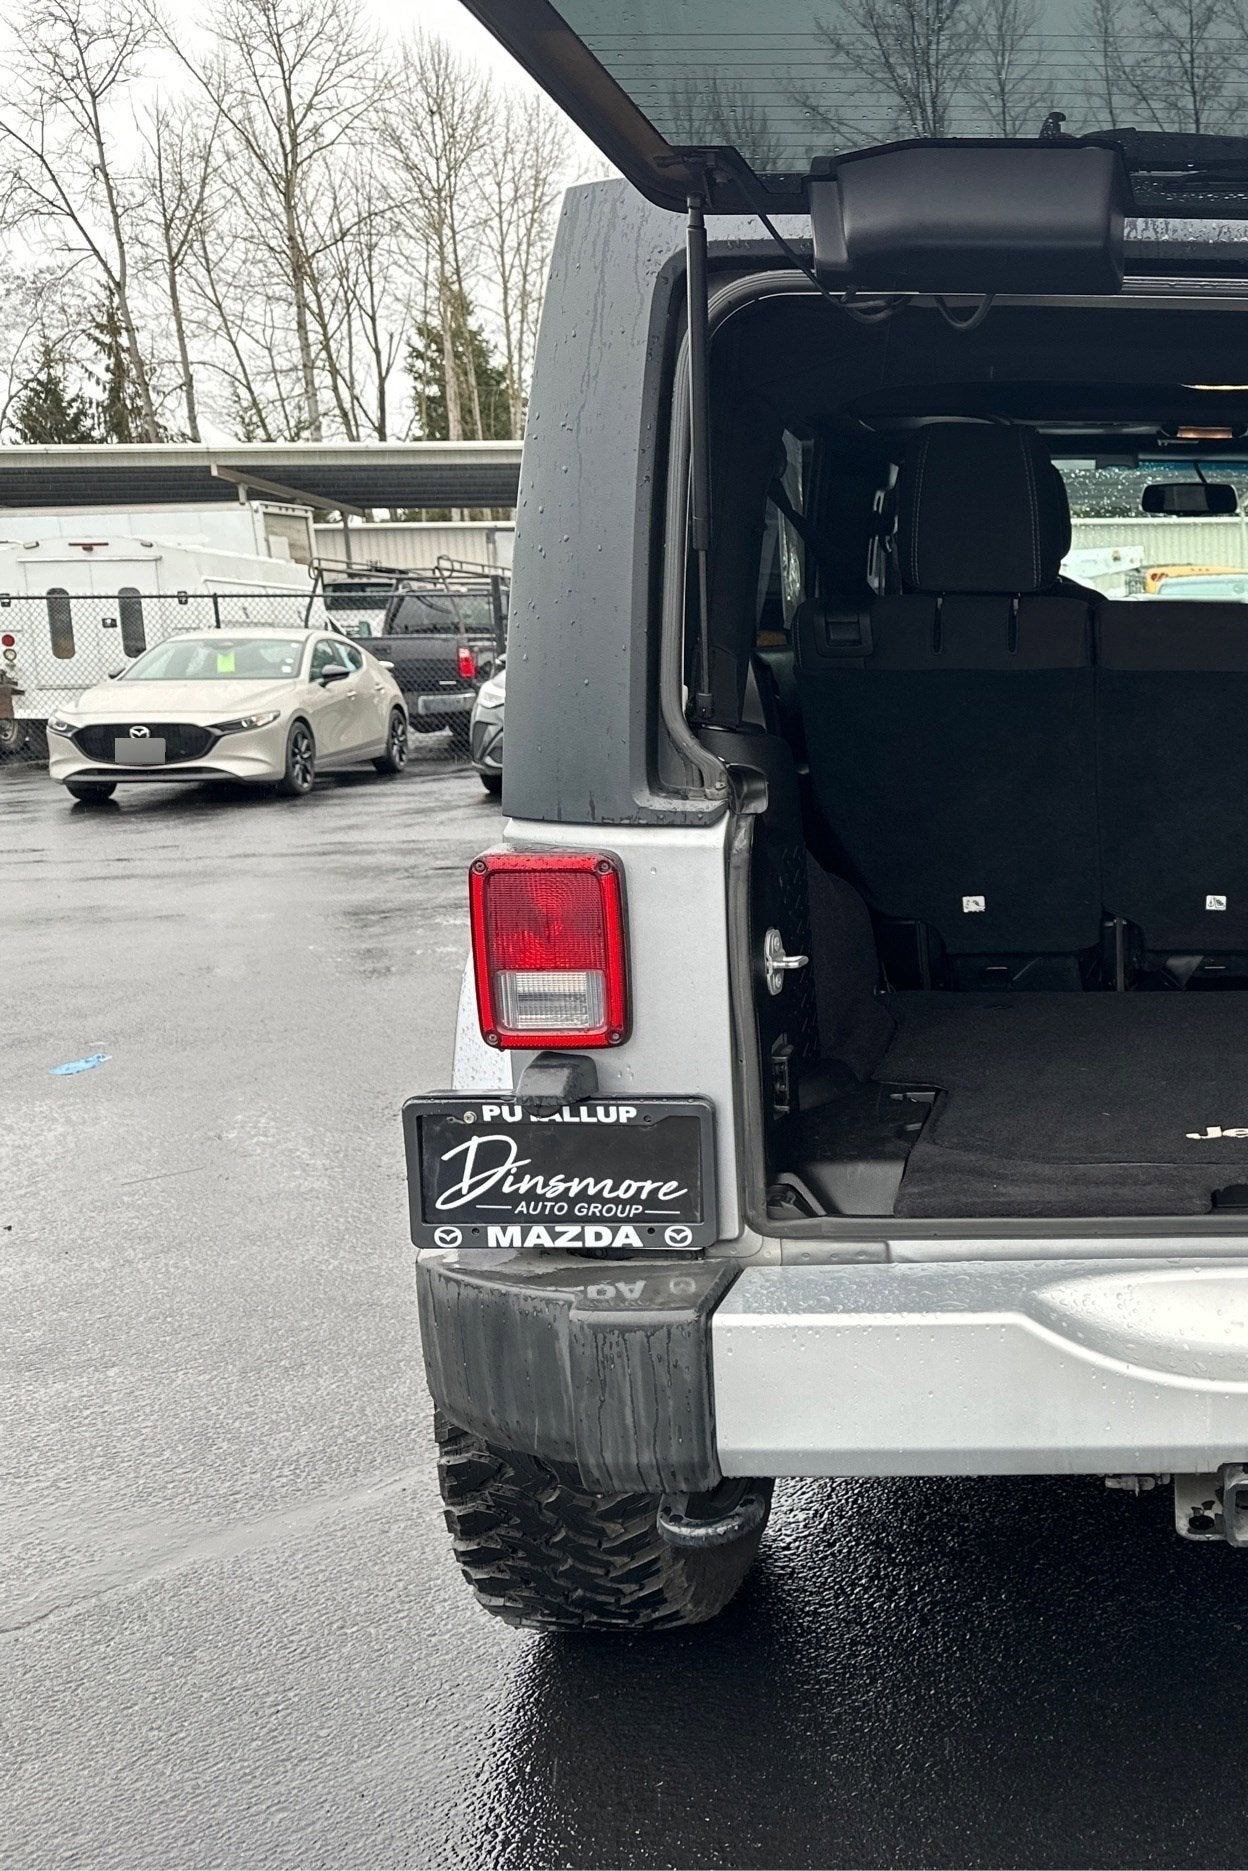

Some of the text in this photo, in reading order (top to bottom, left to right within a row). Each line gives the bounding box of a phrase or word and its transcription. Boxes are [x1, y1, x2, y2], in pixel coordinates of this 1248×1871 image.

[481, 1105, 637, 1123] PUALLUP
[435, 1134, 688, 1210] Dinsmore
[514, 1201, 643, 1218] AUTO GROUP
[486, 1225, 643, 1248] MAZDA
